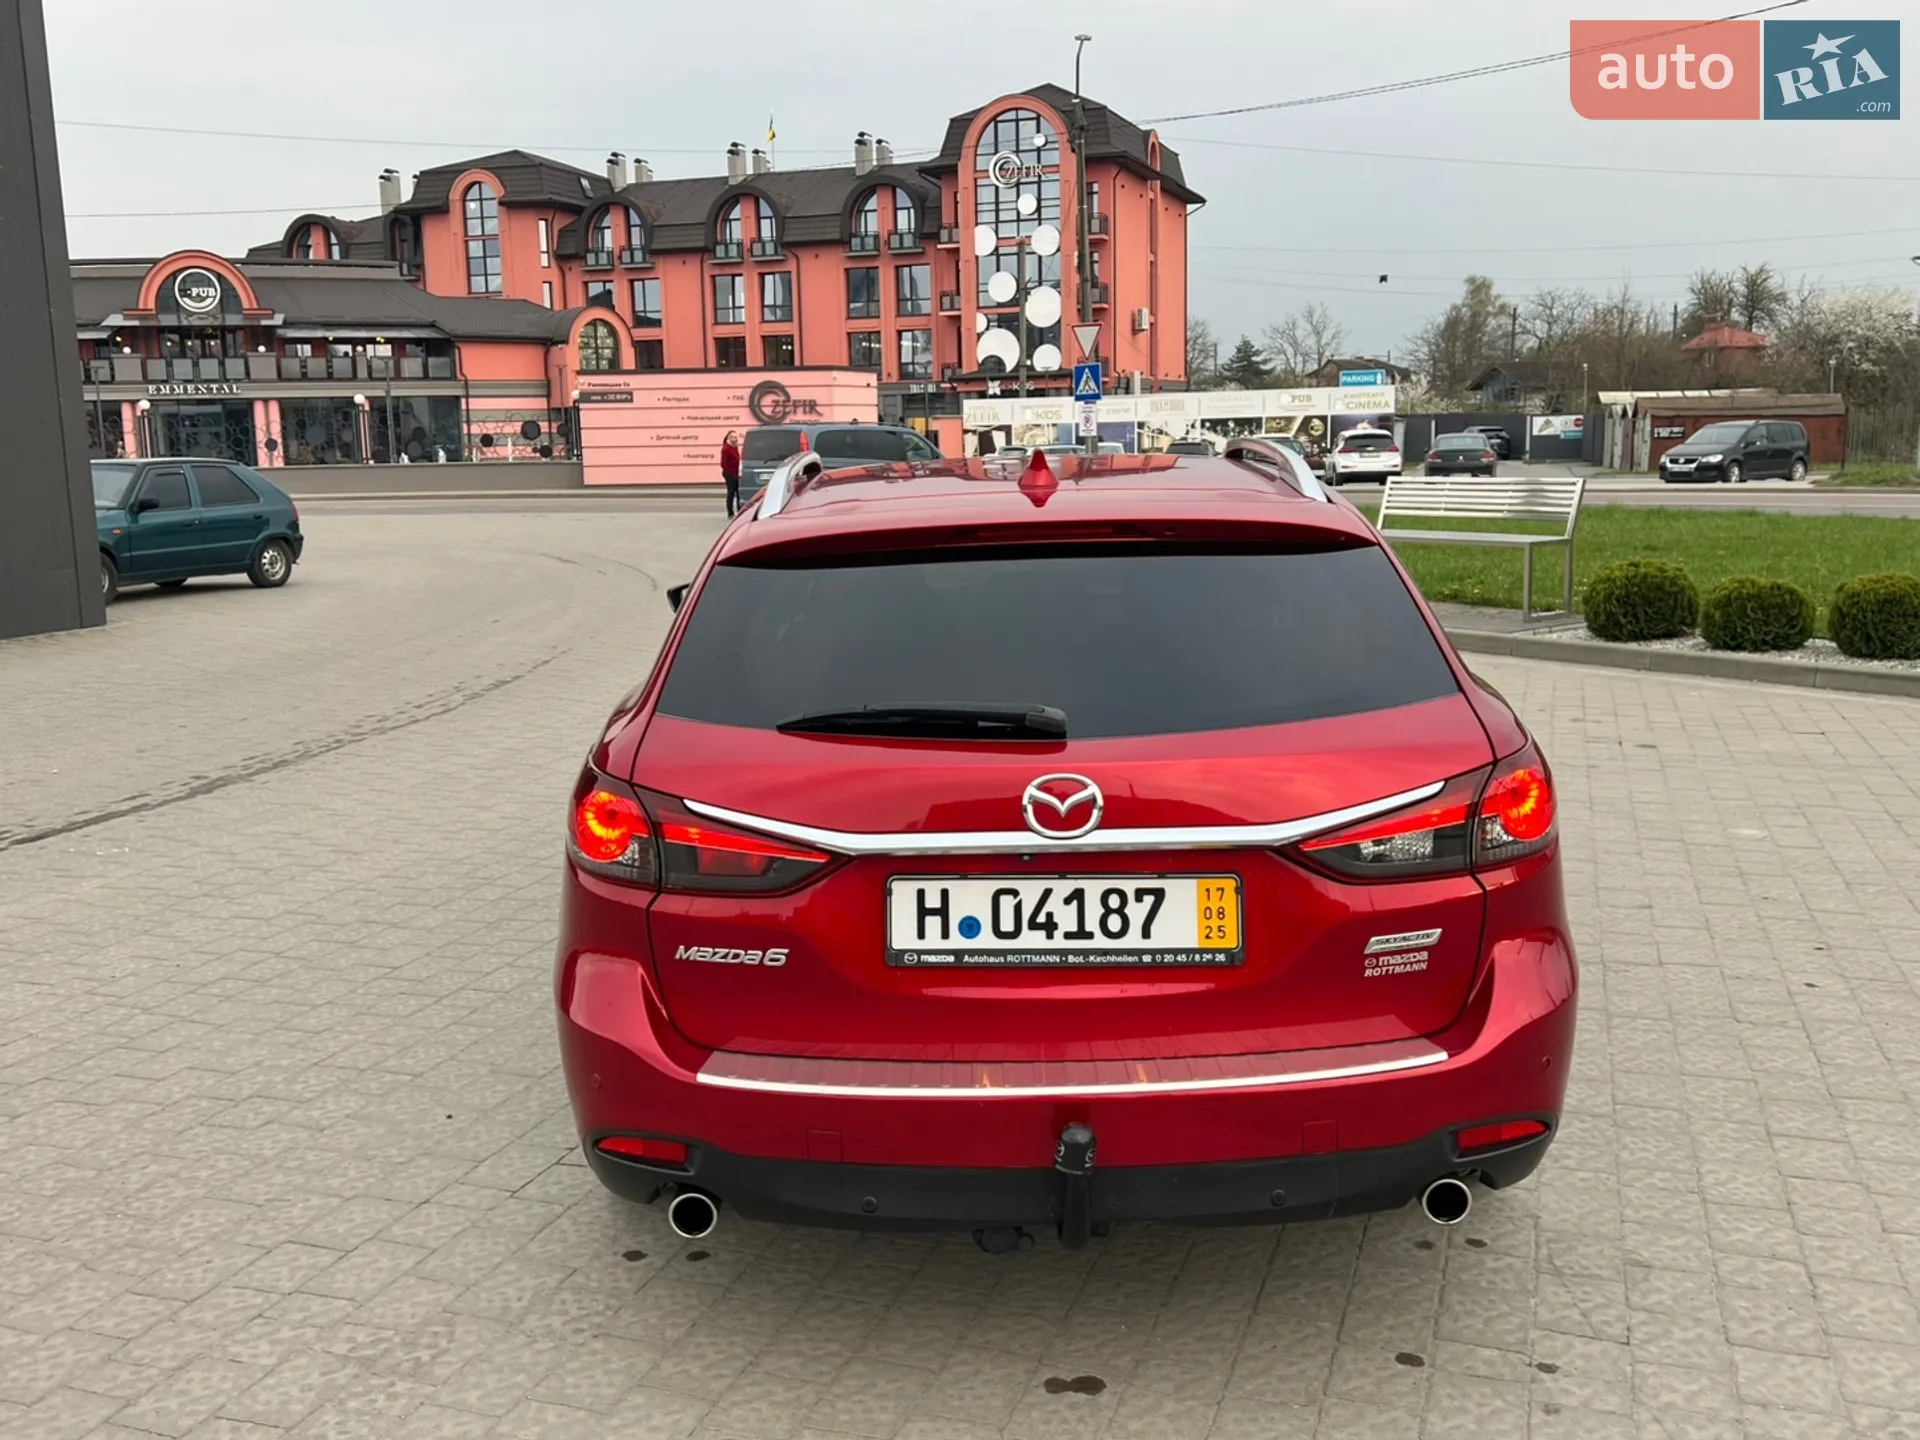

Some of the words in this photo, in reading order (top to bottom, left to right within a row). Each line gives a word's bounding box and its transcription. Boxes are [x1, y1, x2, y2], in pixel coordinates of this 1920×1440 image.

[1342, 375, 1375, 383] PARKING
[148, 384, 241, 395] EMMENTAL
[1291, 394, 1312, 403] PUB
[1347, 400, 1391, 410] CINEMA
[771, 399, 823, 417] ZEFIR
[1205, 887, 1225, 901] 17
[916, 888, 950, 940] H
[991, 887, 1166, 940] 04187
[1204, 906, 1226, 920] 08
[1204, 925, 1227, 939] 25
[963, 954, 1005, 963] Autohaus
[1006, 954, 1060, 963] ROTTMANN
[1163, 954, 1175, 962] 20
[1176, 954, 1187, 962] 45
[1364, 961, 1428, 977] ROTTMANN
